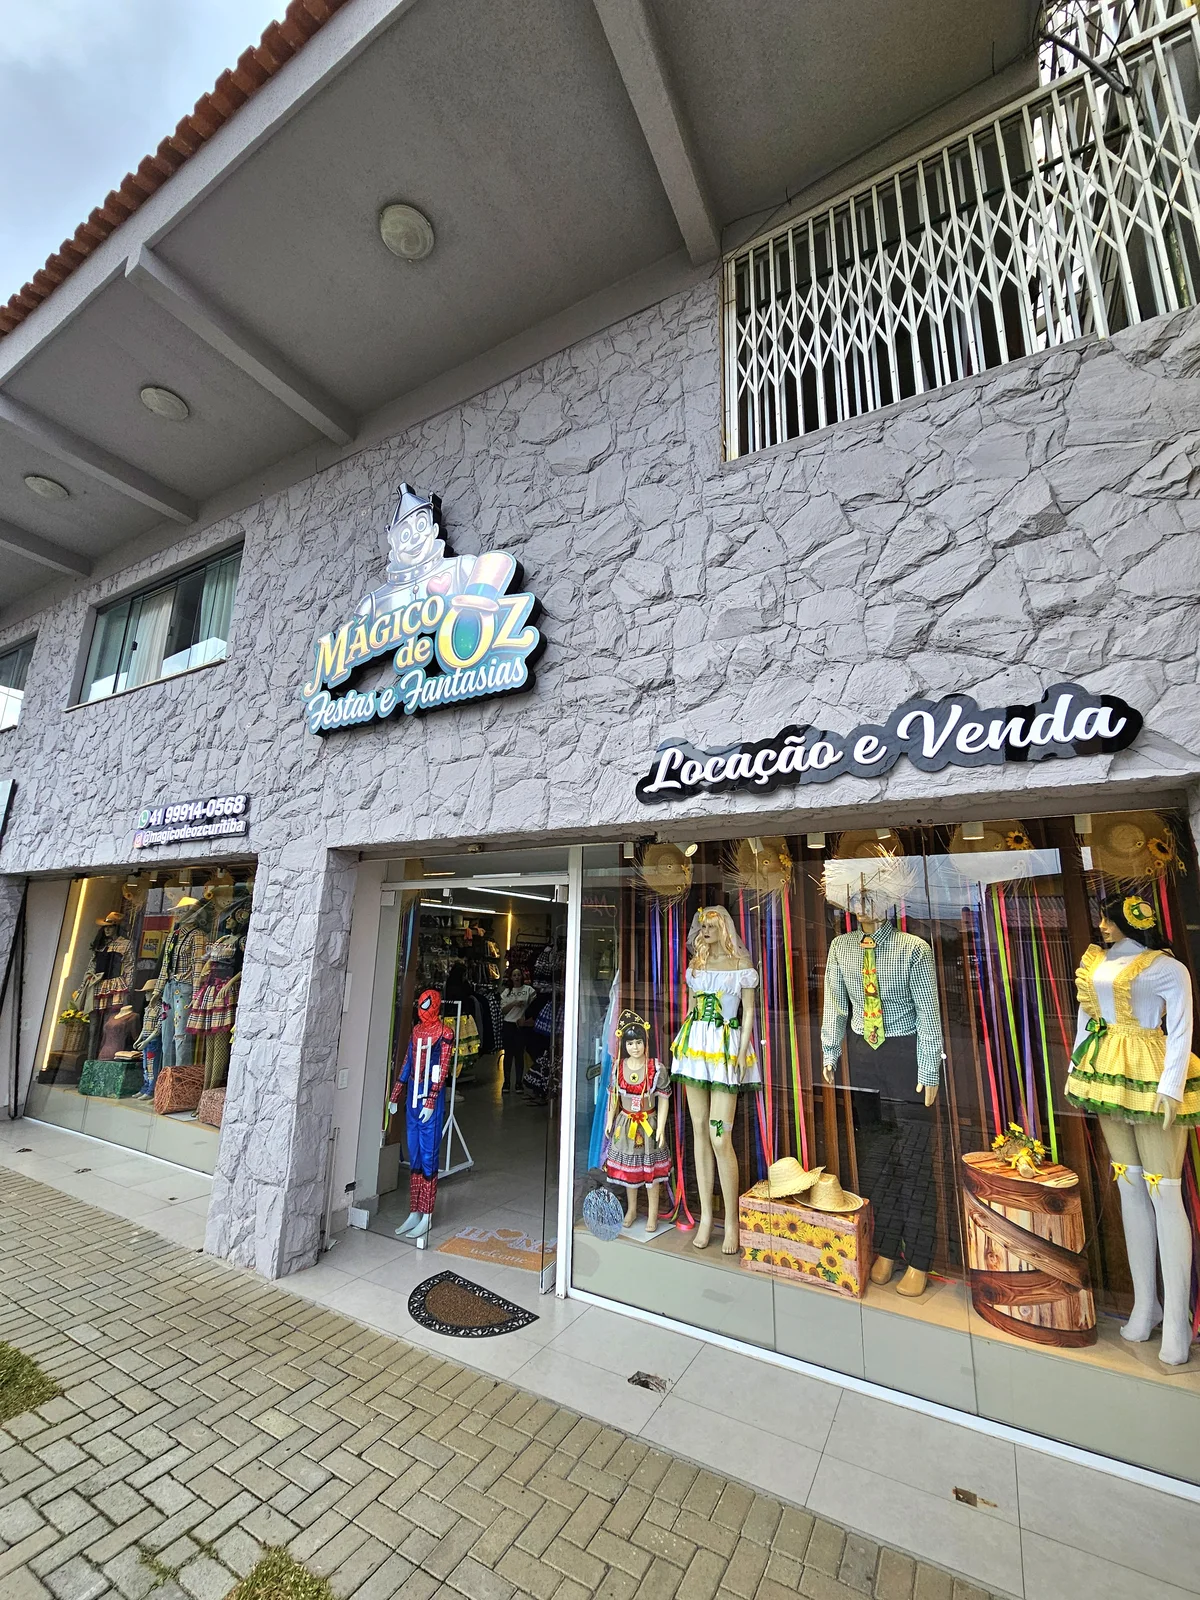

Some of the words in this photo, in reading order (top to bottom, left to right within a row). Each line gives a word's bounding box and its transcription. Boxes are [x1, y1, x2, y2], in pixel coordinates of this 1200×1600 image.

[303, 596, 445, 696] MÁGICO
[396, 637, 431, 669] de
[438, 595, 540, 669] OZ
[307, 692, 375, 731] Festas
[380, 689, 396, 711] e
[400, 657, 526, 712] Fantasias
[642, 735, 844, 794] Locação
[853, 731, 887, 765] e
[896, 693, 1128, 760] Venda
[149, 808, 165, 827] 41
[164, 794, 247, 824] 99914-0568
